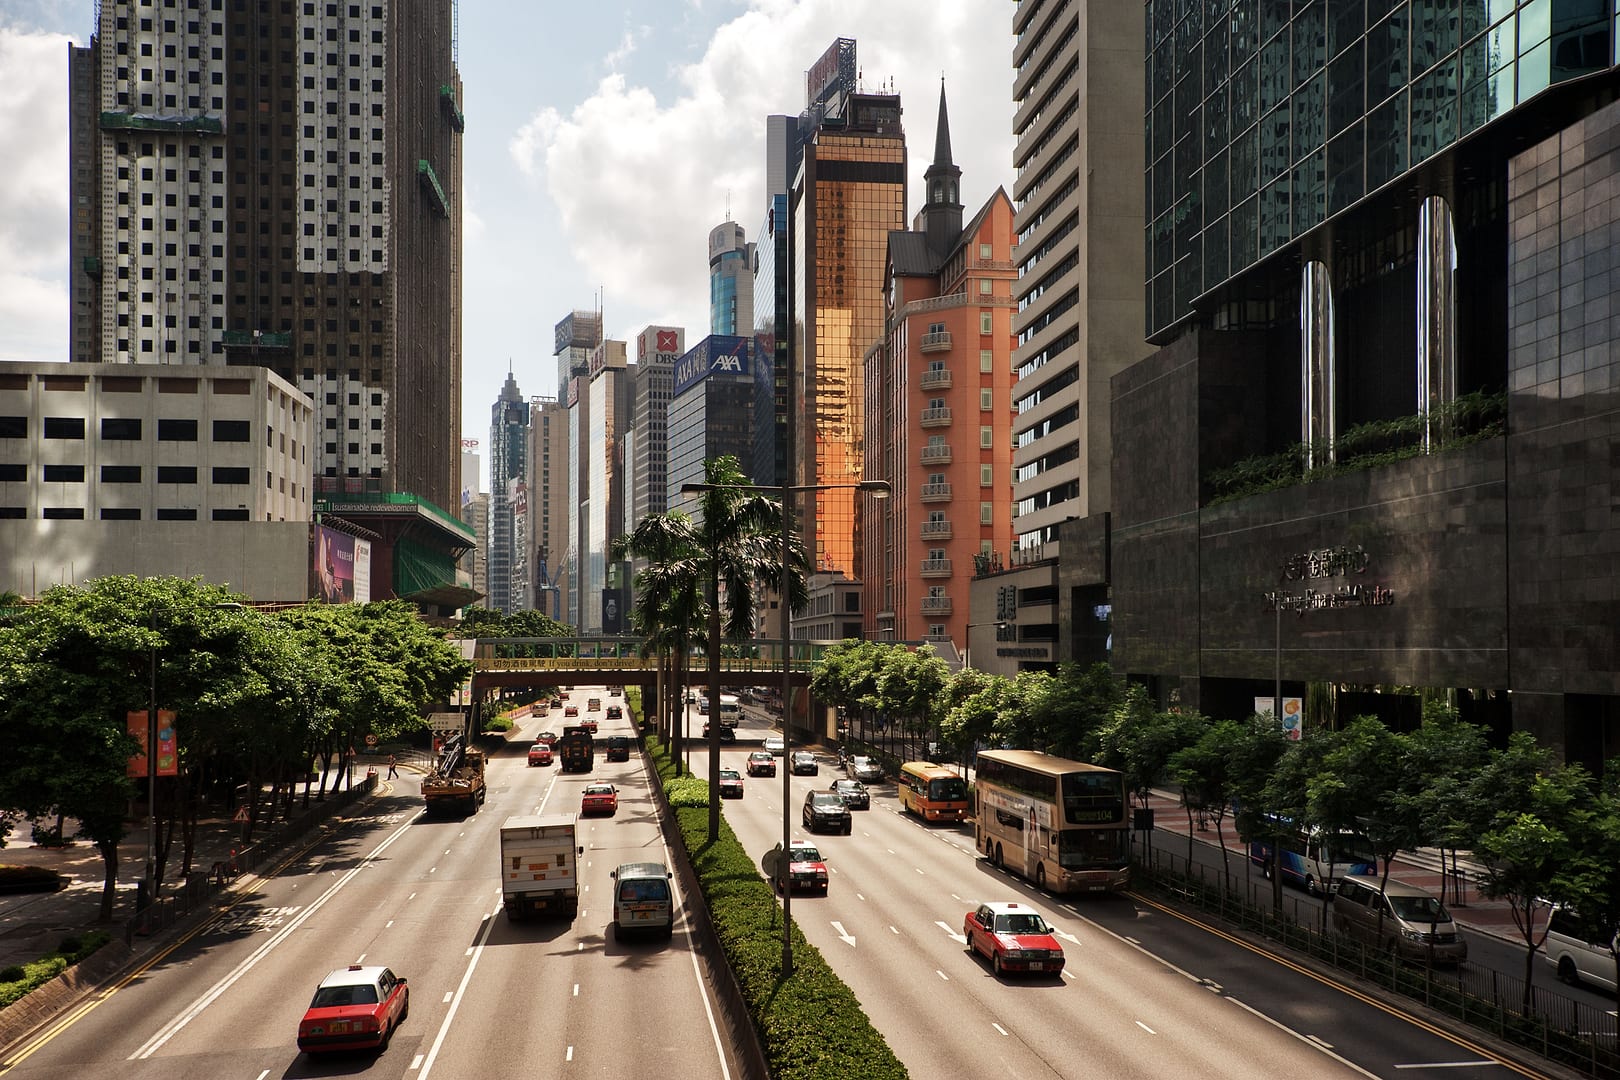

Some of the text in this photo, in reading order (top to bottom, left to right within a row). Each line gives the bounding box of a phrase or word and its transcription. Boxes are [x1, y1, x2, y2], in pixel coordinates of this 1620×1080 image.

[656, 353, 678, 364] DBS
[711, 355, 742, 371] AXA
[677, 359, 692, 386] AXA
[461, 439, 479, 447] RP
[334, 503, 369, 512] sustainable
[370, 503, 416, 512] redevelopment
[493, 660, 545, 668] 切勿酒後駕駛
[1097, 810, 1112, 820] 104
[221, 906, 302, 920] SLOW
